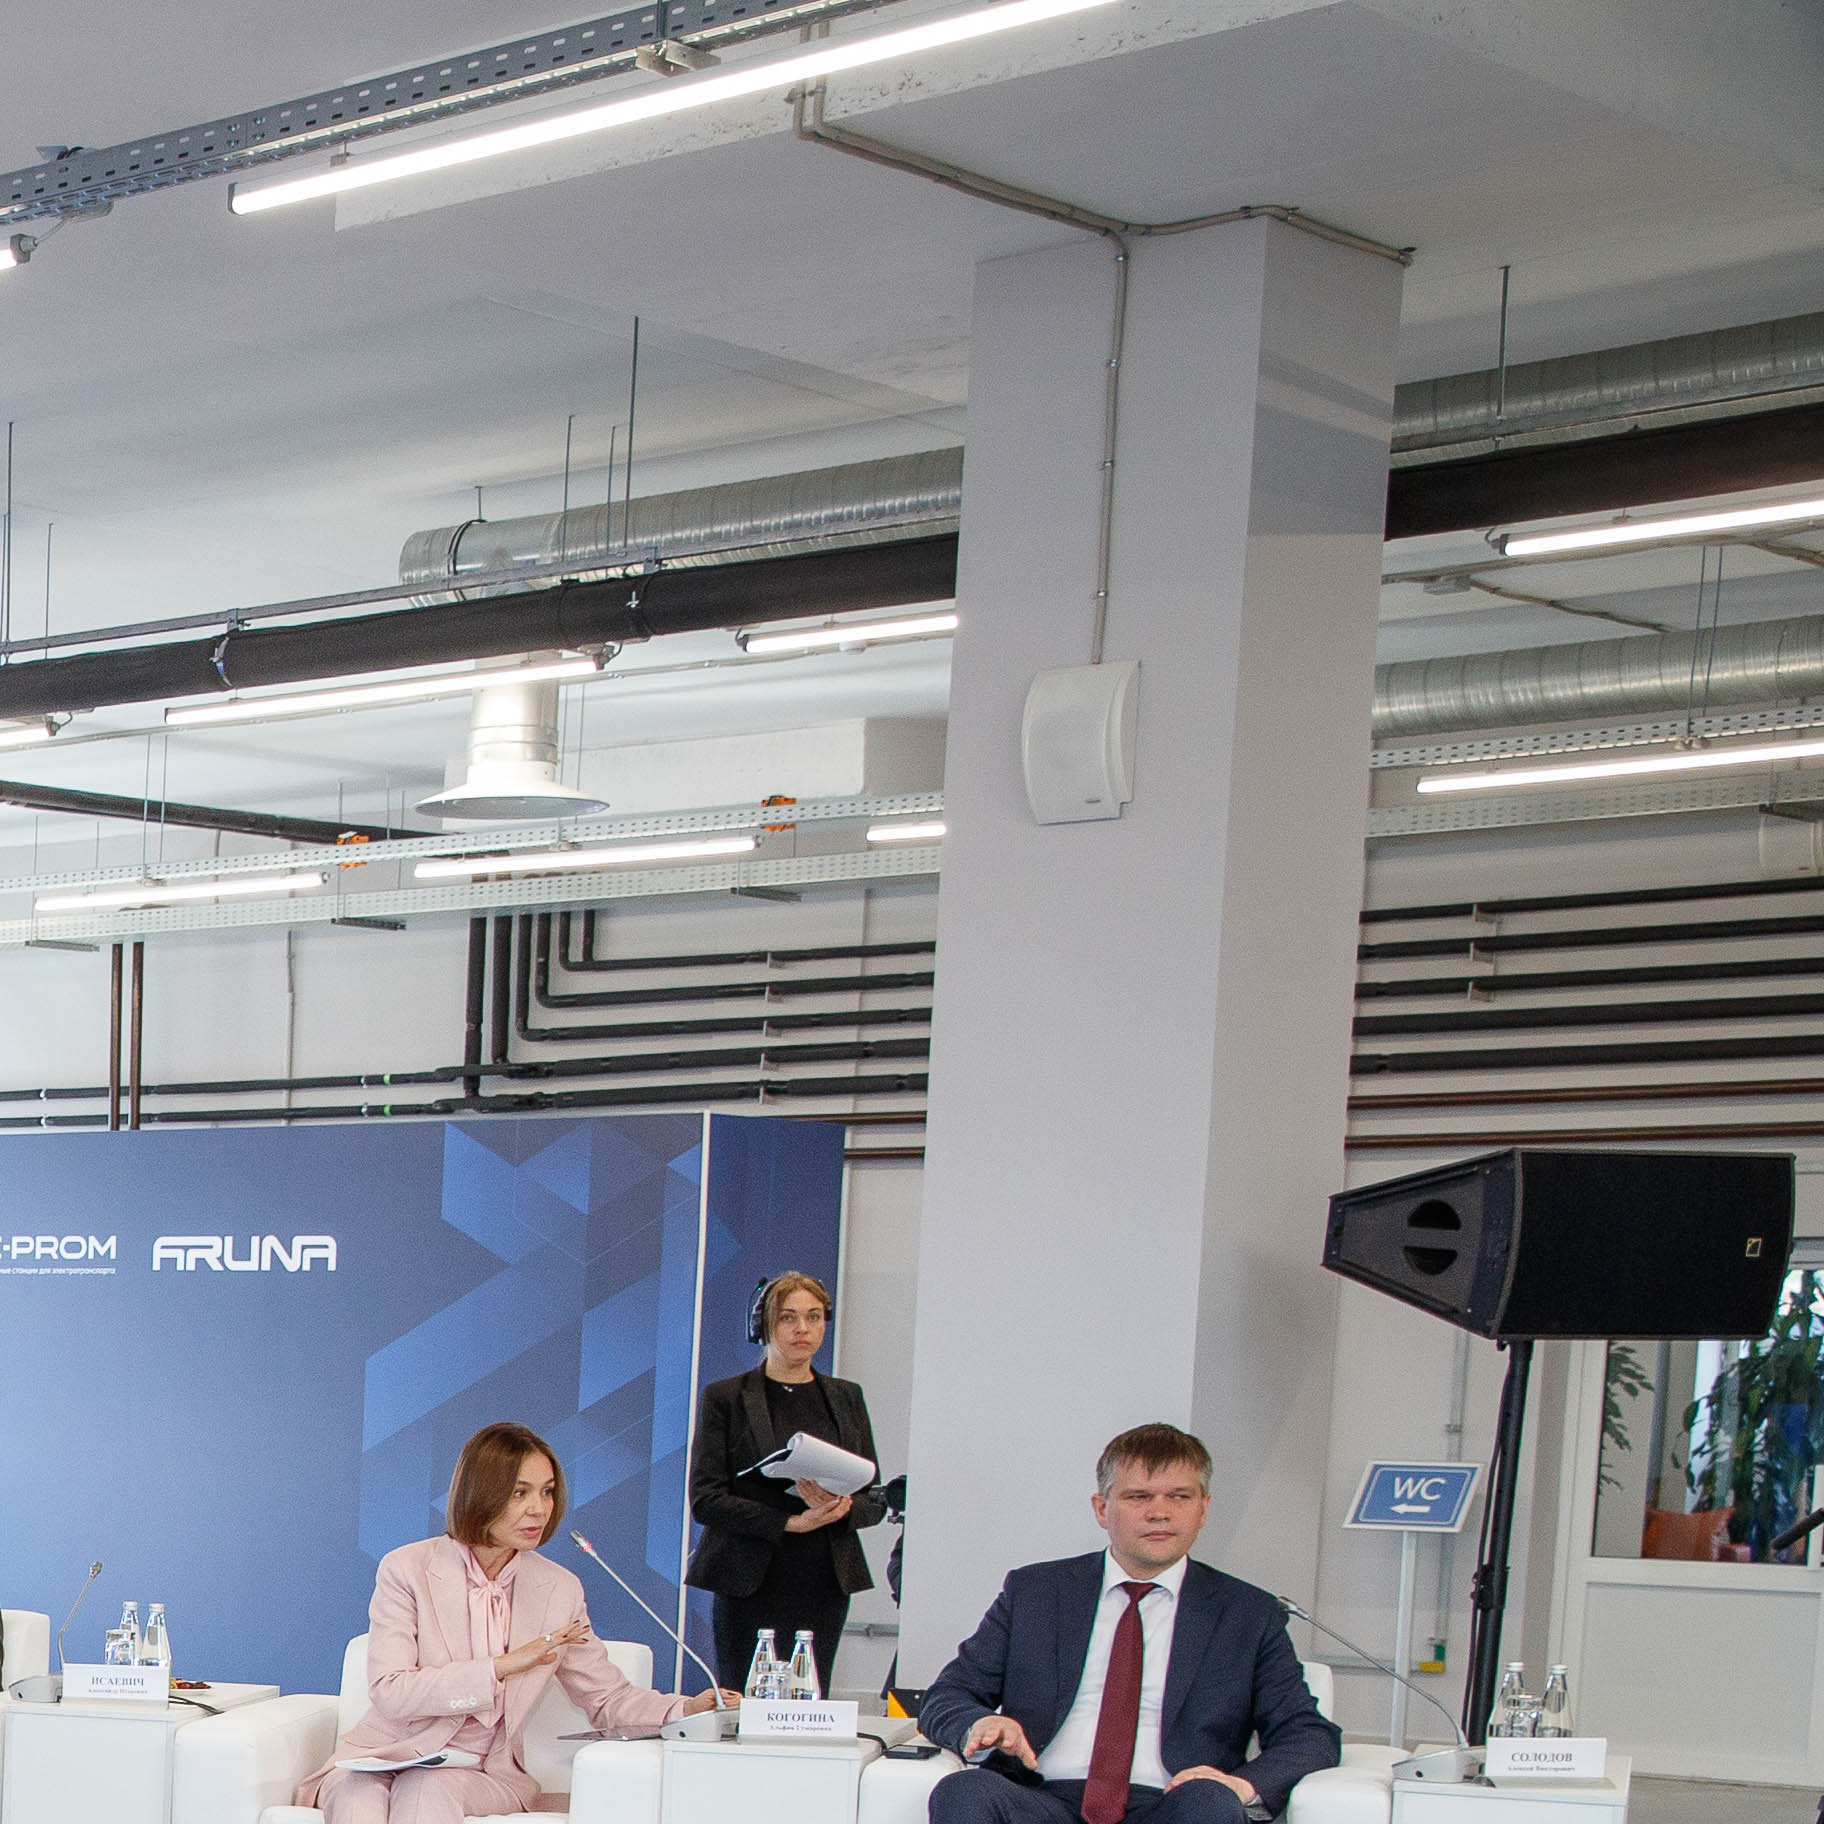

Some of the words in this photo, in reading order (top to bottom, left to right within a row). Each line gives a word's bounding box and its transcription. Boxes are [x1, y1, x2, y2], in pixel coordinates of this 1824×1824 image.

[152, 1235, 337, 1272] ARUNA
[1394, 1476, 1446, 1500] WC
[92, 1676, 145, 1686] ИСАЕВИЧ
[767, 1712, 835, 1722] КОГОГИНА
[1511, 1752, 1574, 1764] СОЛОДОВ
